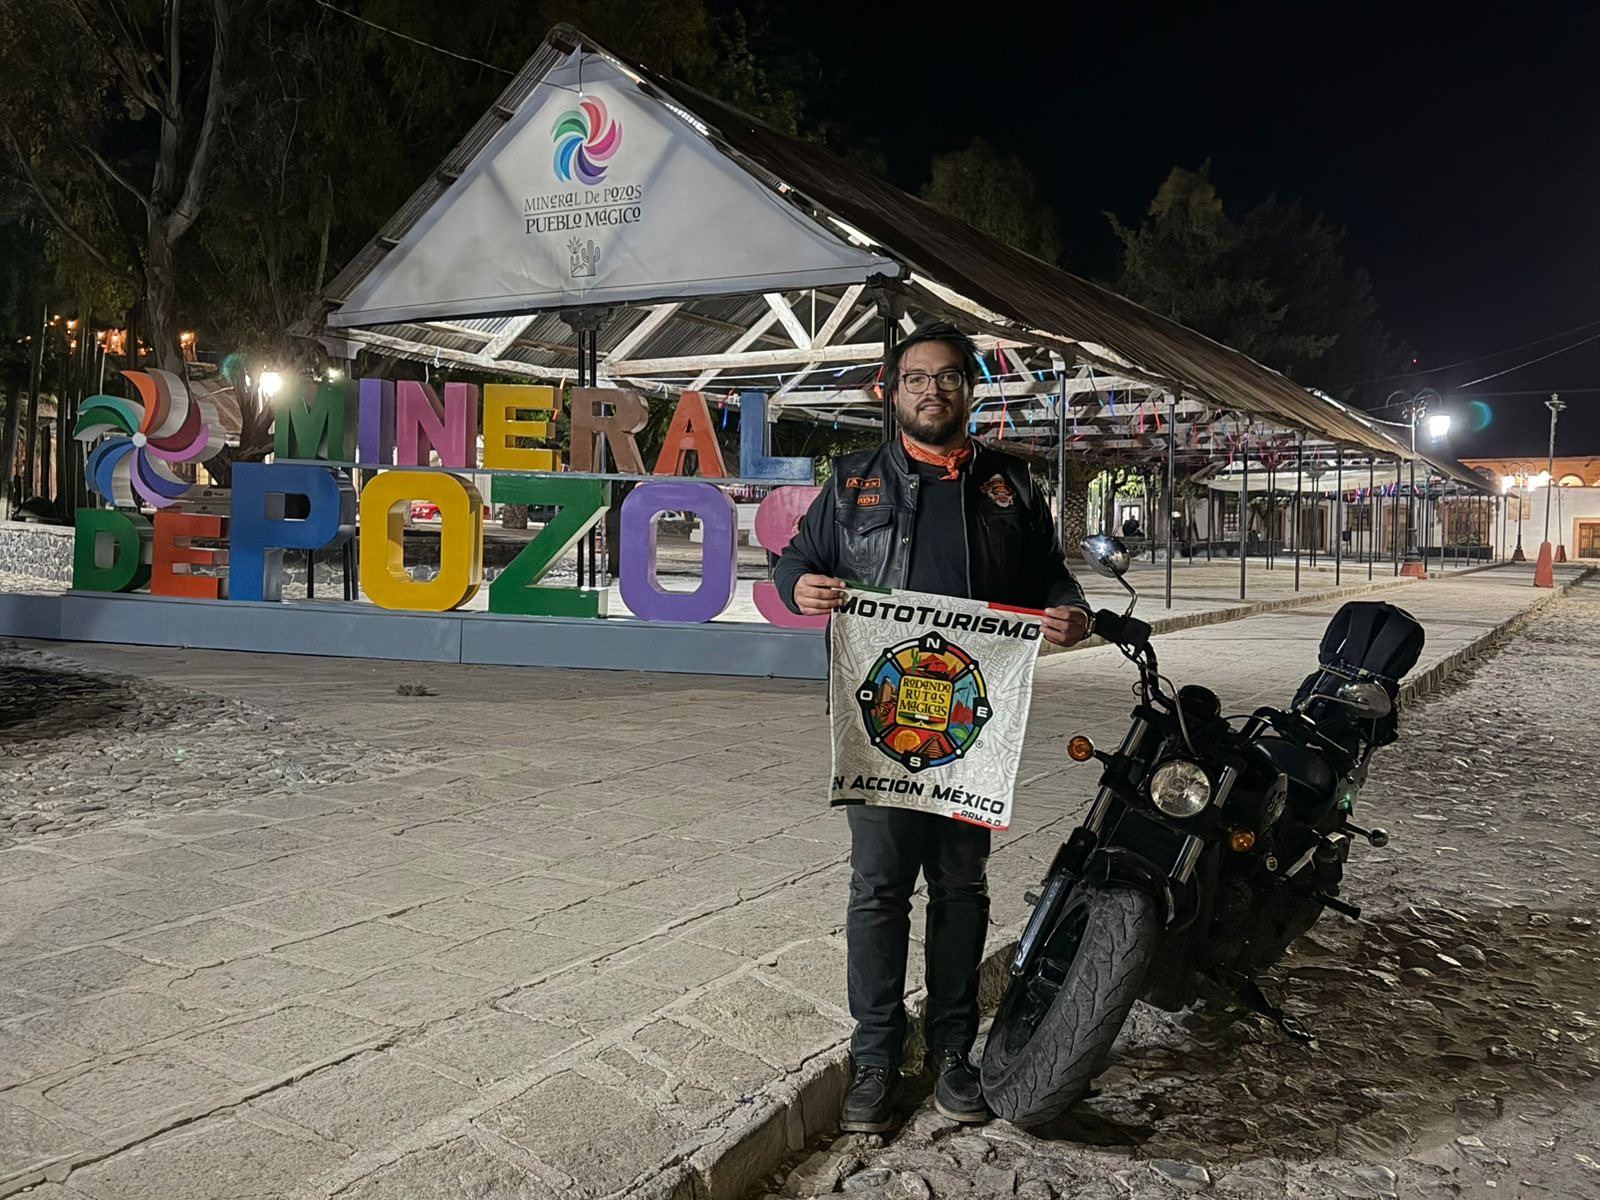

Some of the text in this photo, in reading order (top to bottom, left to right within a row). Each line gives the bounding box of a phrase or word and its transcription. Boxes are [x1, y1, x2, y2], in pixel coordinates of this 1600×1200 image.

[273, 378, 815, 480] MINERAL
[72, 508, 226, 600] DE
[833, 596, 1041, 641] MOTOTURISMO
[926, 638, 940, 649] N
[976, 706, 988, 718] E
[909, 756, 921, 767] S
[850, 774, 925, 796] ACCIÓN
[931, 784, 1005, 815] MÉXICO
